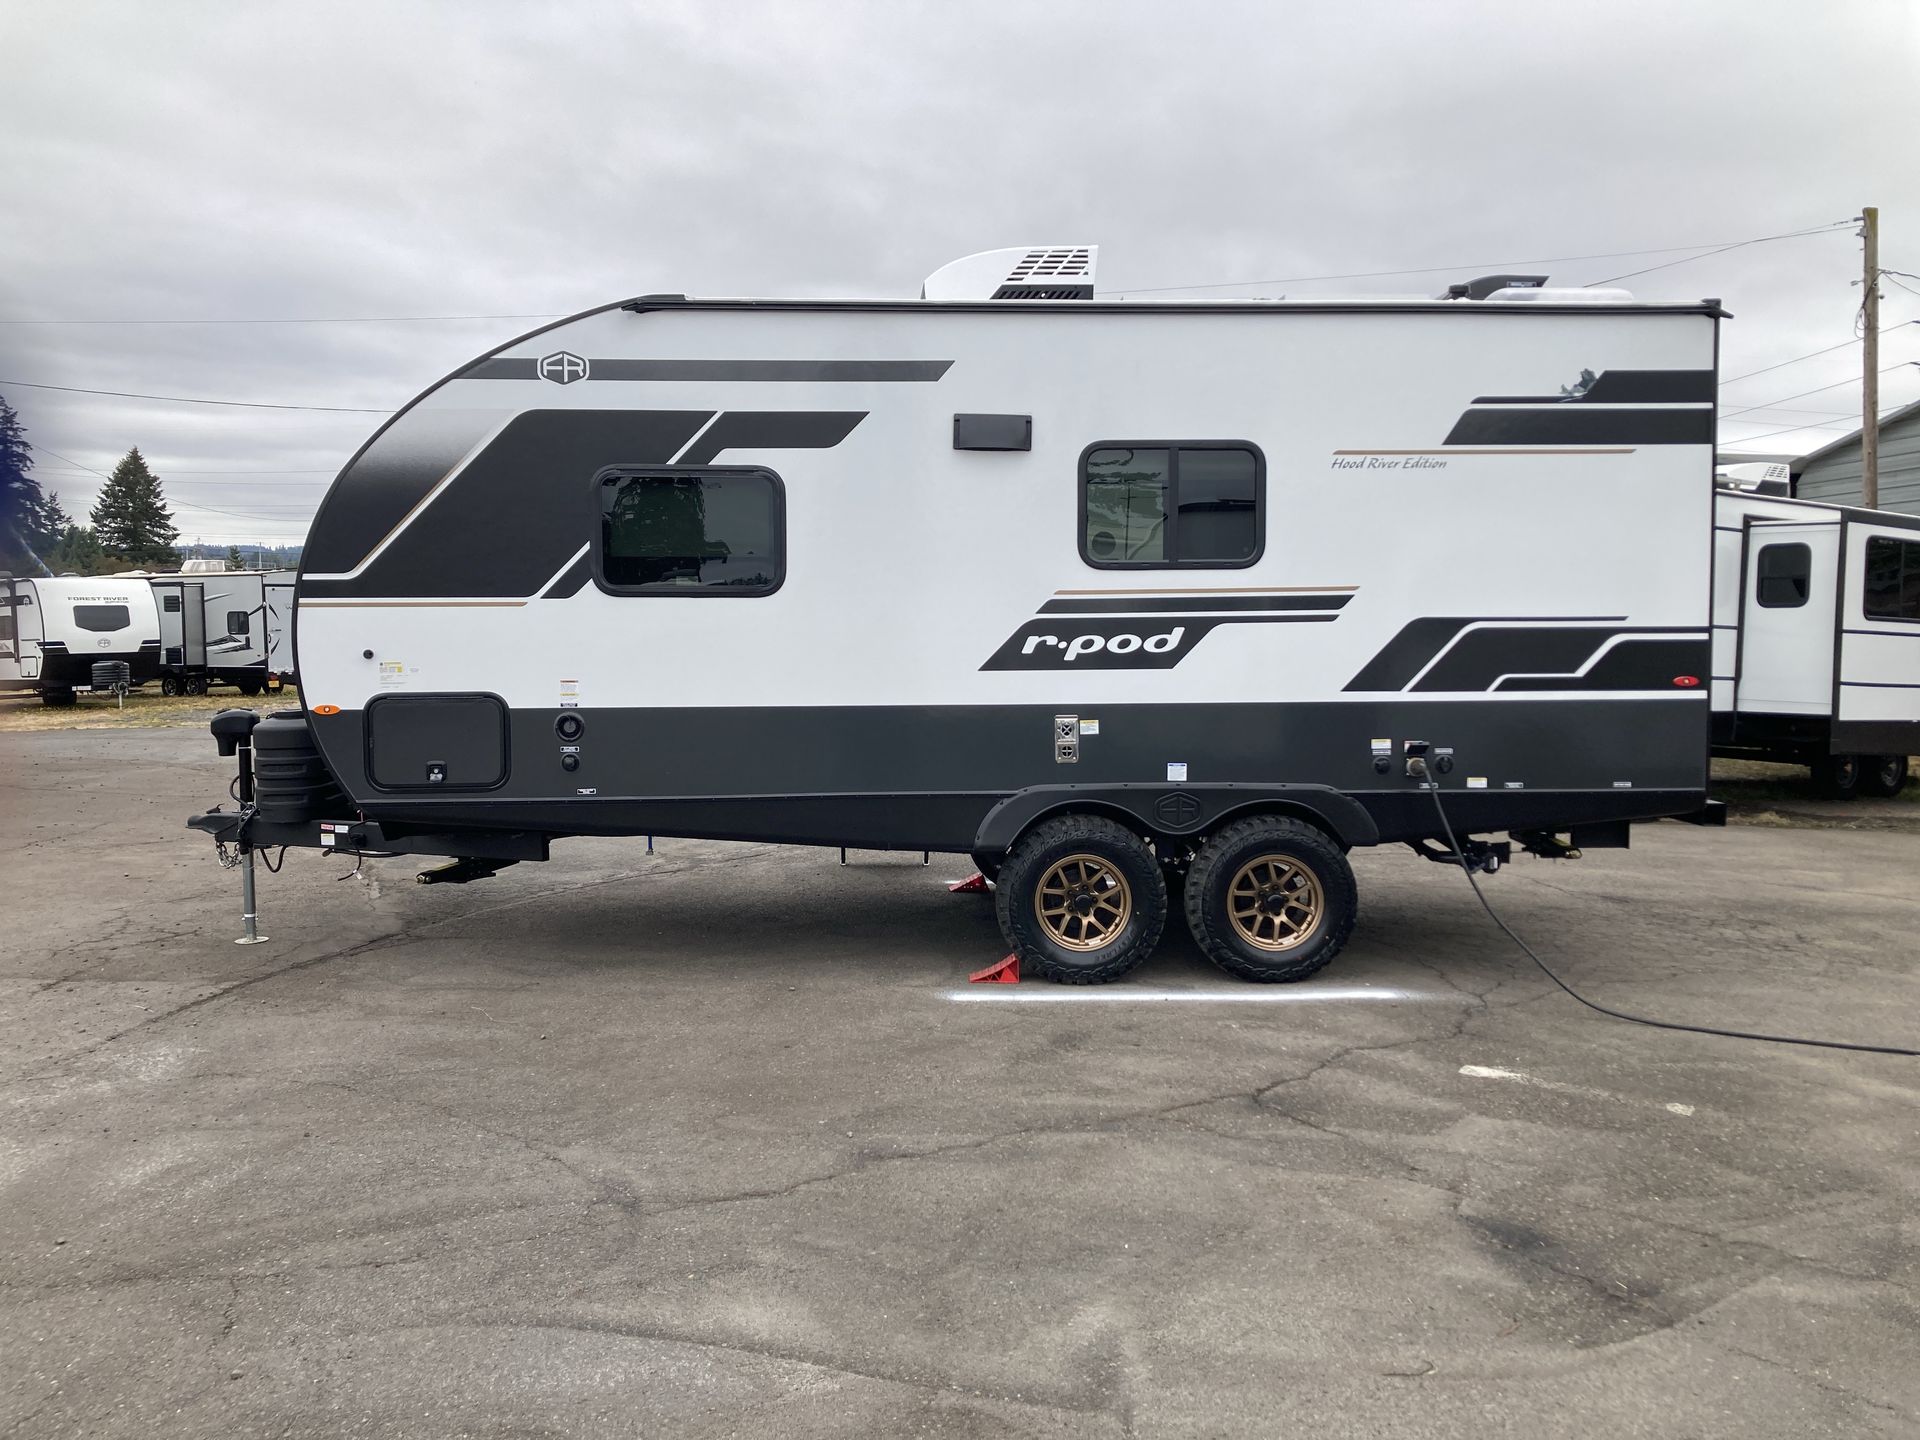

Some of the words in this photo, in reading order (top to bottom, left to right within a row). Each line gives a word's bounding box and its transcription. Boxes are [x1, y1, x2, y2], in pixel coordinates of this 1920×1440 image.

[1331, 456, 1367, 469] Hood
[1367, 457, 1400, 469] River
[1402, 456, 1448, 469] Edition
